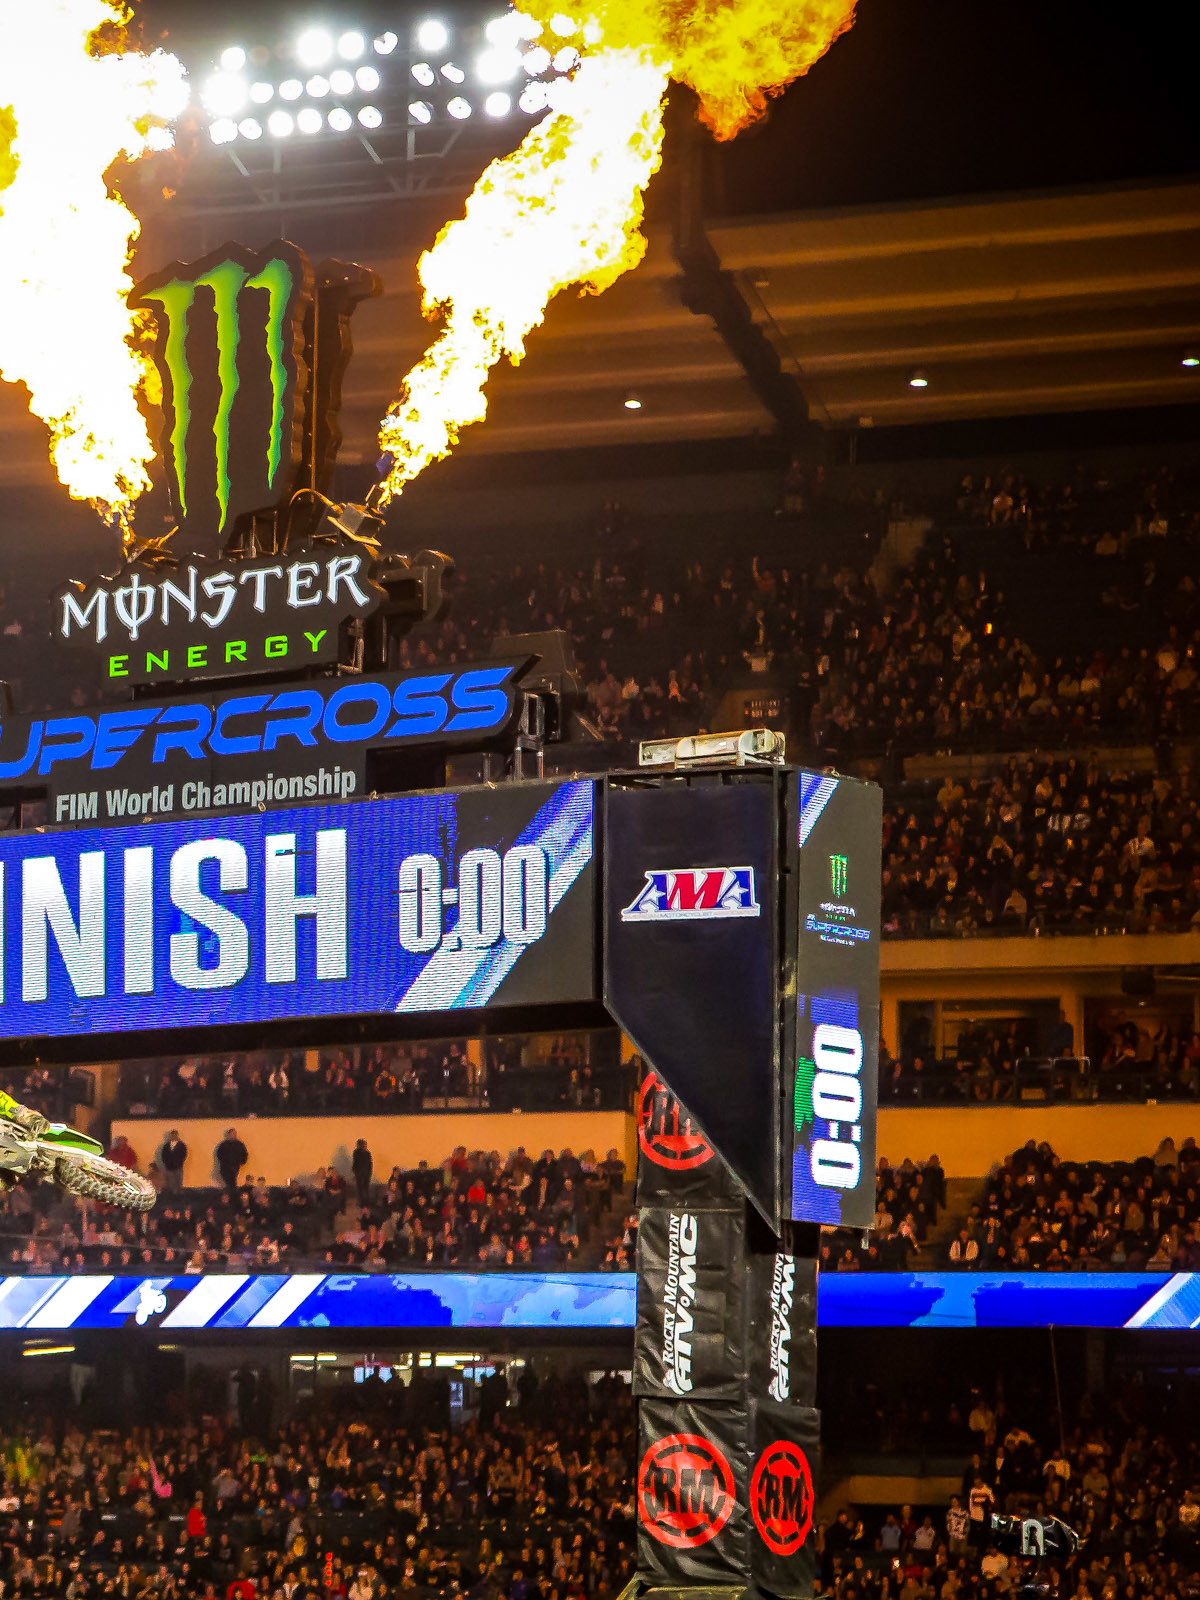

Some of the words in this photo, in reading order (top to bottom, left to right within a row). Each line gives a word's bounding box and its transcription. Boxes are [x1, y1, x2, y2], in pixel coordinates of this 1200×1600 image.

[60, 554, 371, 643] MONSTER
[109, 629, 328, 677] ENERGY
[56, 793, 97, 822] FIM
[104, 782, 173, 815] World
[181, 766, 356, 810] Championship
[398, 845, 548, 954] 0:00
[623, 867, 759, 914] AMA
[811, 1023, 863, 1190] 0:00
